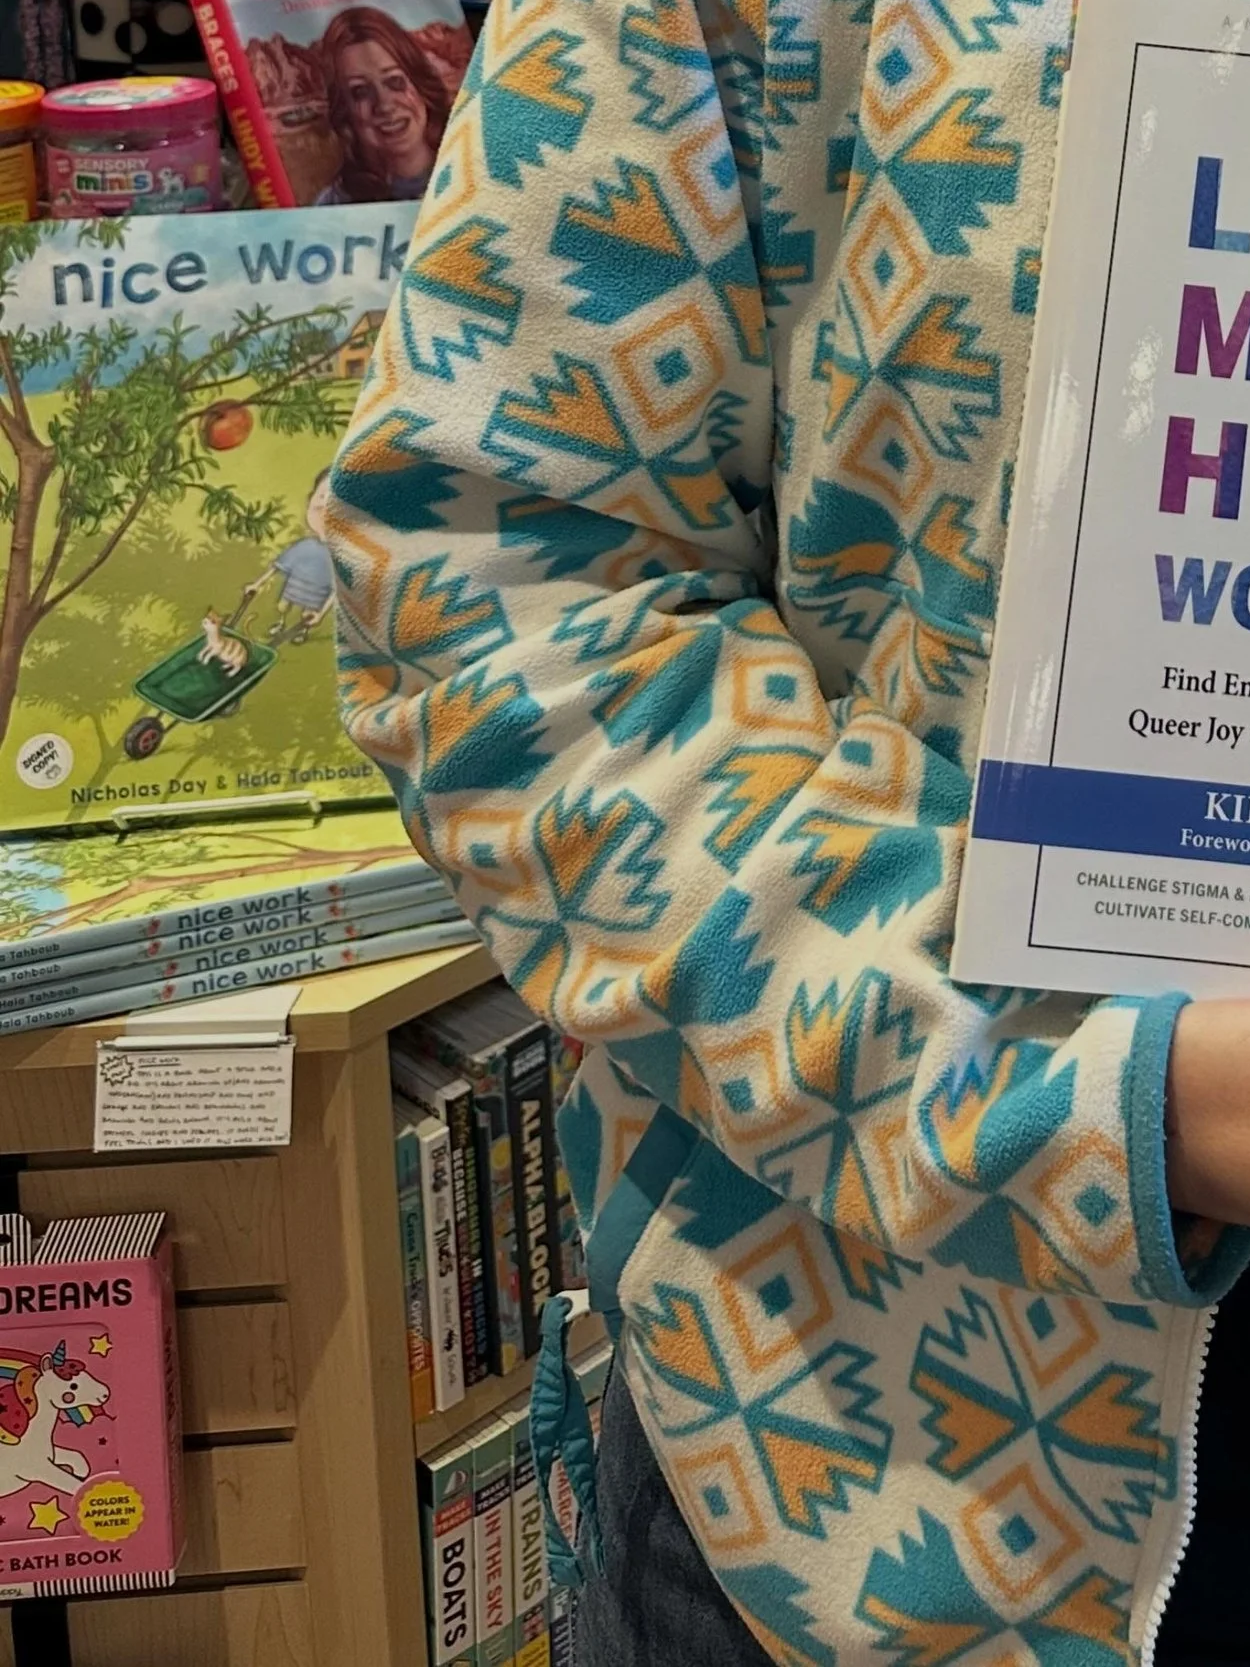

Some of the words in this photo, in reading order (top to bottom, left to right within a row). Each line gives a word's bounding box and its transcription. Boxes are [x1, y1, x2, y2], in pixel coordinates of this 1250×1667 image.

[1222, 16, 1232, 28] A
[197, 8, 238, 95] BRACES
[231, 107, 264, 175] LINDY
[74, 157, 150, 171] SENSORY
[75, 173, 150, 192] minis
[52, 248, 208, 308] nice
[238, 224, 409, 285] work
[1160, 666, 1217, 694] Find
[1128, 708, 1202, 739] Queer
[1206, 716, 1245, 750] Joy
[22, 740, 56, 771] SIGNED
[32, 749, 60, 775] COPY!
[71, 782, 161, 804] Nicholas
[168, 778, 208, 796] Day
[216, 776, 228, 790] &
[237, 768, 283, 790] Hala
[289, 763, 375, 786] Tahboub
[1077, 871, 1169, 894] CHALLENGE
[1171, 880, 1230, 901] STIGMA
[1233, 886, 1246, 902] &
[177, 906, 233, 931] nice
[243, 888, 314, 920] work
[1094, 900, 1177, 922] CULTIVATE
[178, 928, 234, 952] nice
[243, 909, 314, 937] work
[9, 942, 61, 963] Tahboub
[195, 946, 251, 973] nice
[258, 928, 330, 956] work
[10, 964, 62, 984] Tahboub
[191, 971, 248, 995] nice
[256, 952, 327, 982] work
[29, 985, 80, 1006] Tahboub
[23, 1007, 76, 1028] Tahboub
[84, 1507, 121, 1519] APPEAR
[124, 1505, 137, 1515] IN
[89, 1494, 131, 1507] COLORS
[93, 1517, 131, 1529] WATER!
[485, 1508, 501, 1533] IN
[9, 1554, 61, 1574] BATH
[65, 1548, 123, 1569] BOOK
[486, 1540, 502, 1583] THE
[521, 1494, 543, 1602] TRAINS
[442, 1537, 467, 1649] BOATS
[486, 1586, 503, 1629] SKY
